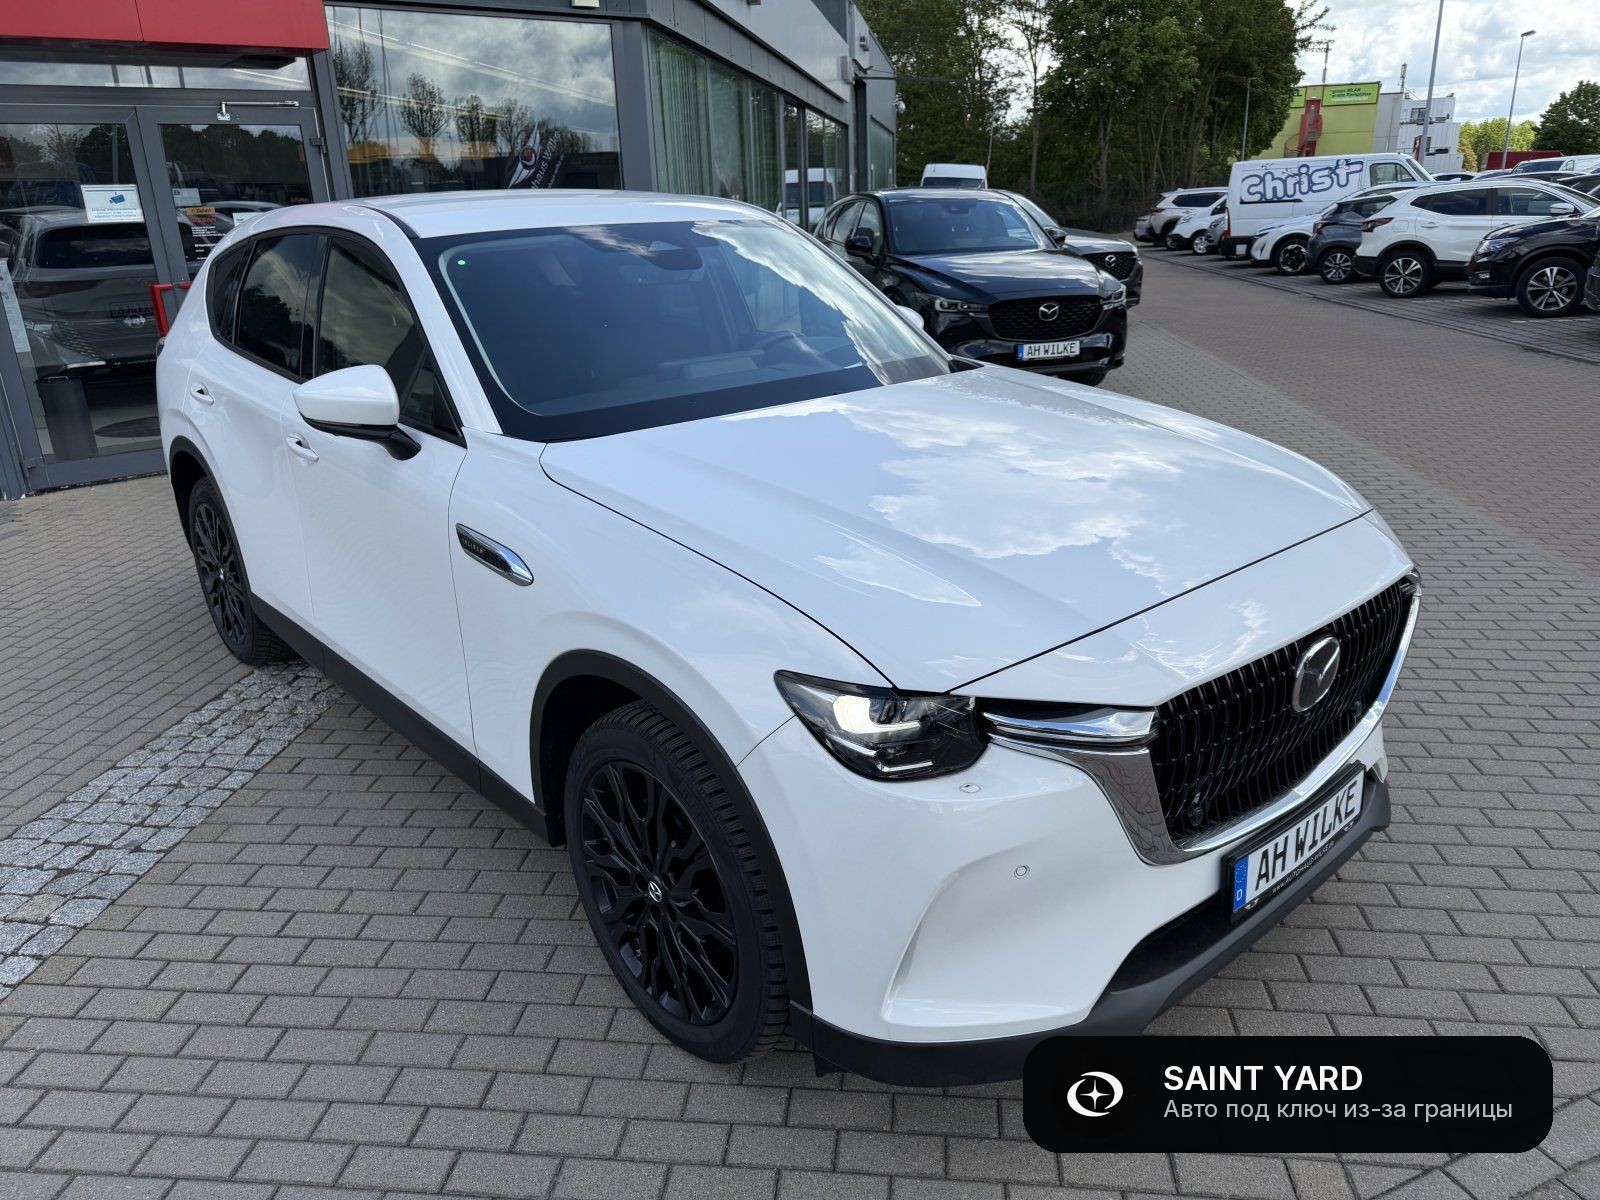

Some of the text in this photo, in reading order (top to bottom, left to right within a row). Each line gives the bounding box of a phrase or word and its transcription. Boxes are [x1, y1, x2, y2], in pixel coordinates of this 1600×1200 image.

[542, 130, 561, 161] Wilke
[1027, 343, 1076, 356] AH WILKE
[1255, 780, 1357, 890] AH WILKE
[1237, 889, 1242, 901] D
